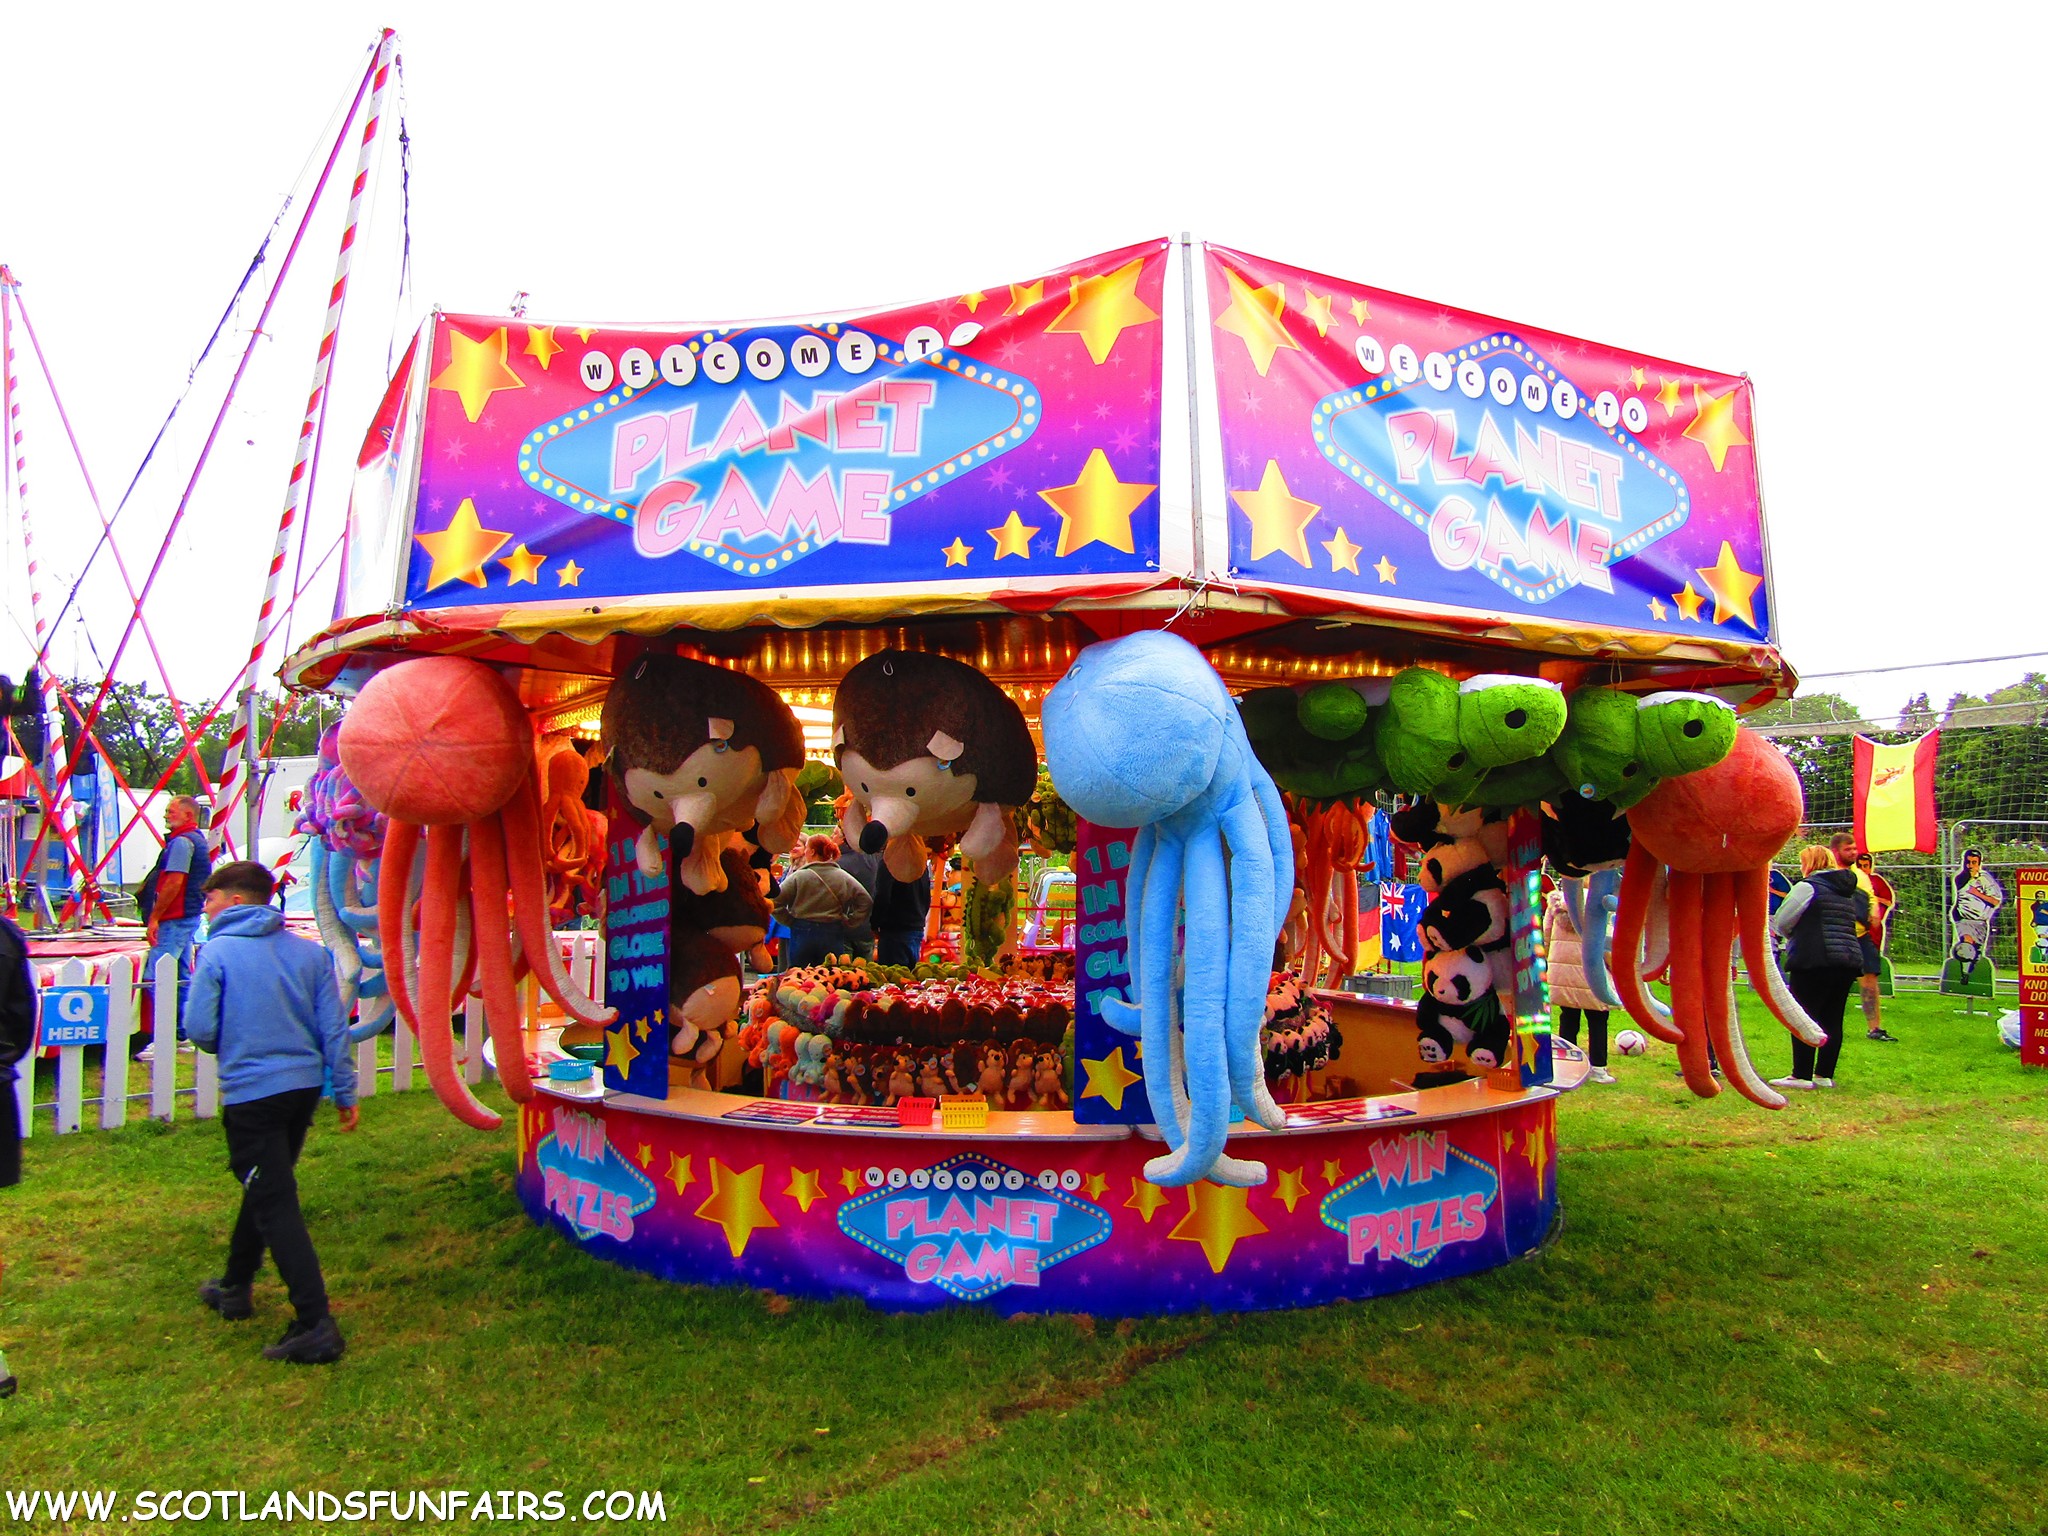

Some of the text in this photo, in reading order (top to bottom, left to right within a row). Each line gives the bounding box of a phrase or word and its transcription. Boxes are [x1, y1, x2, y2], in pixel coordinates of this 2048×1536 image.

[583, 337, 870, 386] WELCOME
[1358, 340, 1644, 428] WELCOME TO
[610, 379, 937, 491] PLANET
[1386, 407, 1624, 521] PLANET
[633, 461, 890, 558] GAME
[1427, 495, 1615, 594] GAME
[610, 832, 669, 866] 1 BL
[1083, 846, 1102, 874] 1
[608, 872, 630, 903] IN
[1081, 879, 1121, 916] IN
[607, 899, 670, 930] COLOURED
[609, 931, 665, 961] GLOBE
[609, 963, 665, 993] TO WIN
[2030, 991, 2048, 1002] DO
[58, 989, 94, 1024] Q
[2037, 1011, 2045, 1020] 2
[48, 1025, 100, 1041] HERE
[552, 1103, 607, 1165] WIN
[866, 1168, 1078, 1189] WELCOME TO
[1368, 1129, 1449, 1196] WIN
[543, 1168, 636, 1243] PRIZES
[884, 1192, 1060, 1243] PLANET
[1346, 1191, 1488, 1266] PRIZES
[903, 1239, 1042, 1288] GAME
